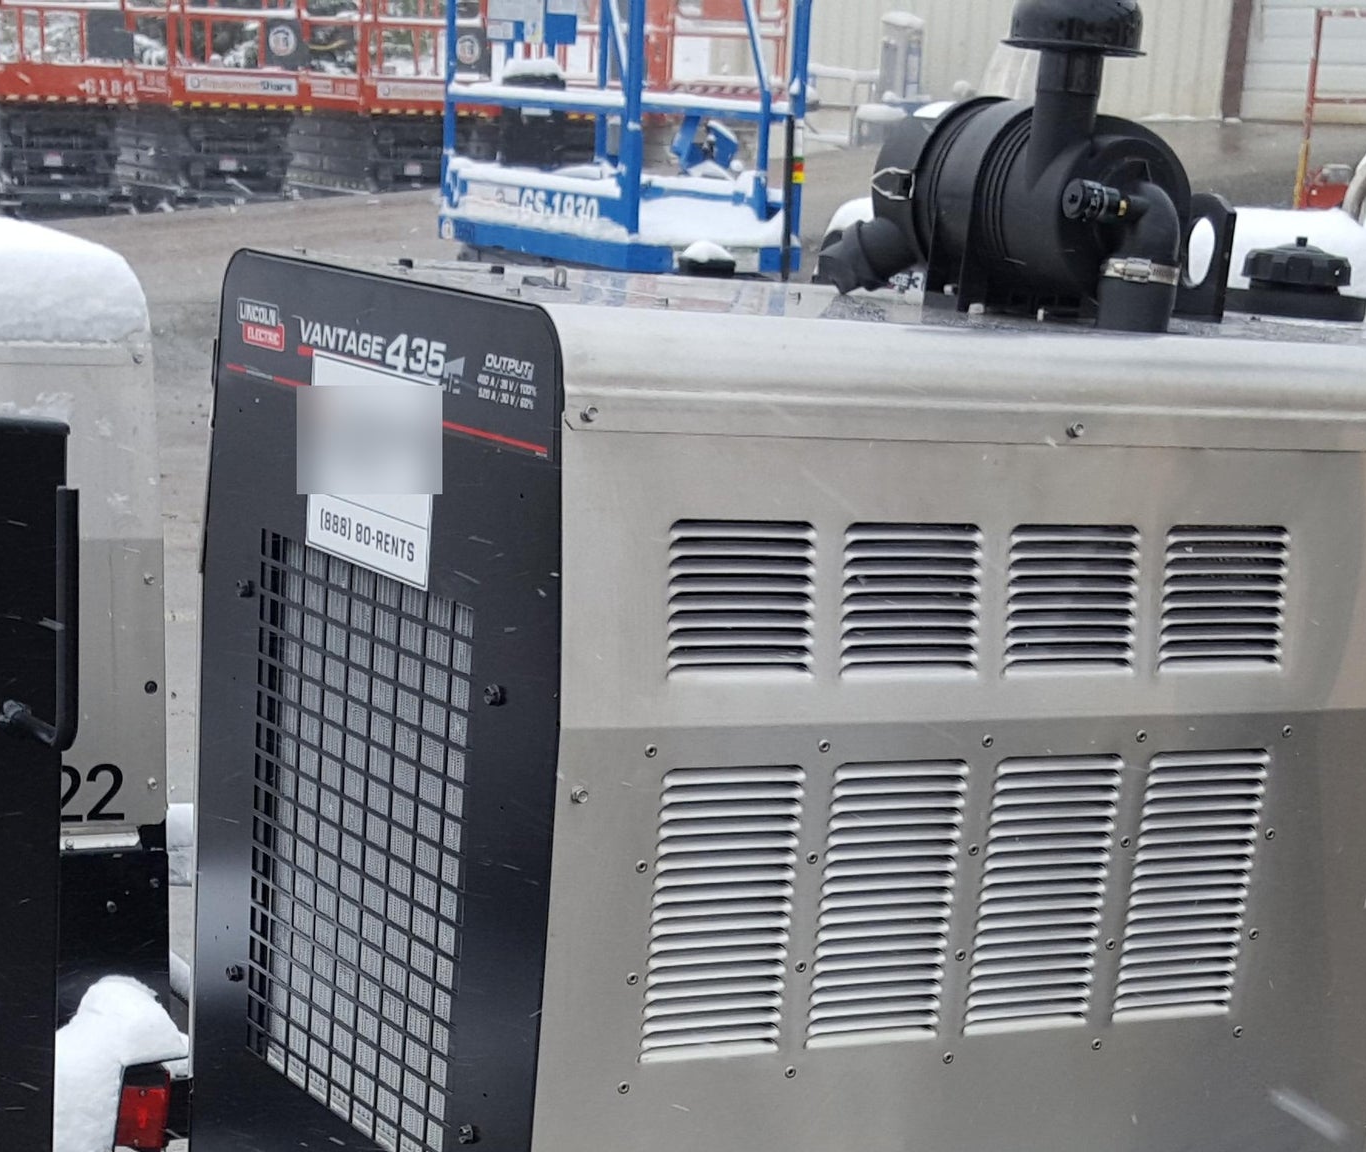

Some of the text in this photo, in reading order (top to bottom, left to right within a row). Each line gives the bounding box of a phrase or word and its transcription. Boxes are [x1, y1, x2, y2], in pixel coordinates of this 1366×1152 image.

[239, 301, 277, 327] LINCOLN
[246, 325, 281, 346] ELECTRIC
[292, 314, 447, 377] VANTAGE 435
[320, 507, 415, 562] (888) 80-RENTS
